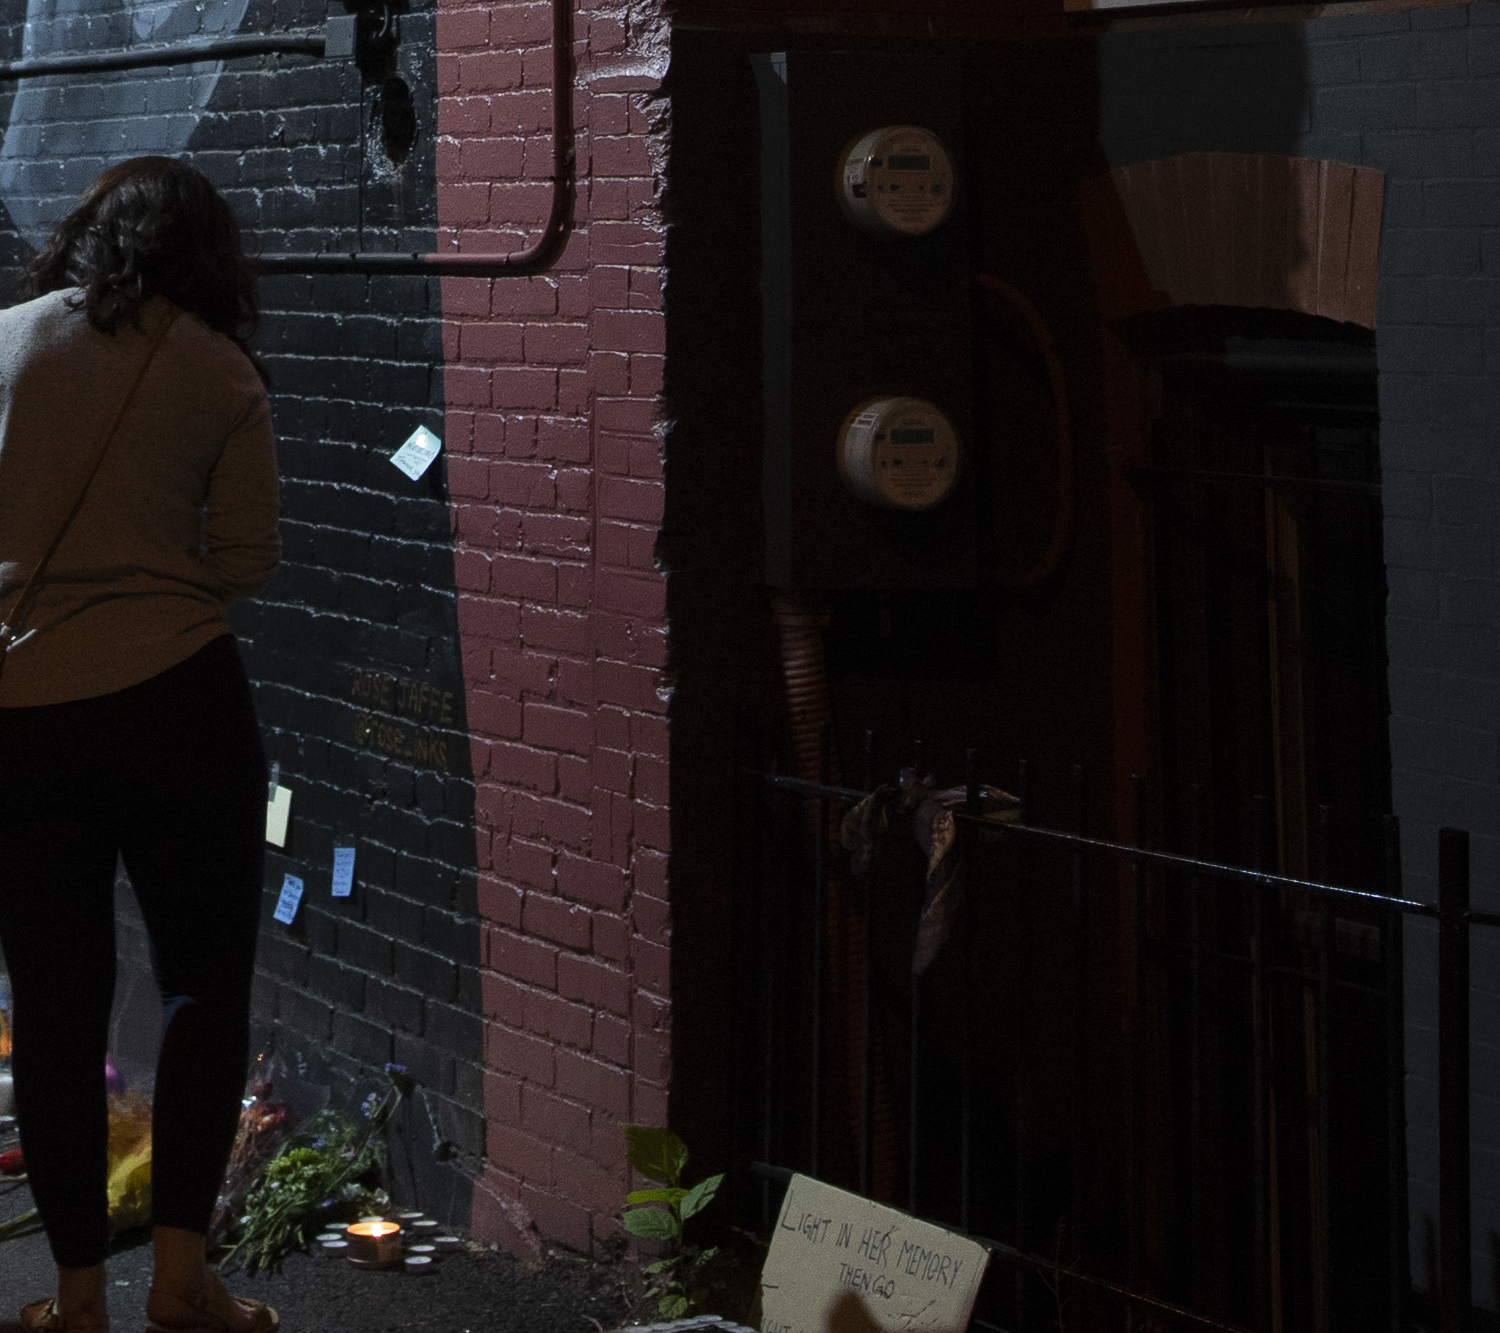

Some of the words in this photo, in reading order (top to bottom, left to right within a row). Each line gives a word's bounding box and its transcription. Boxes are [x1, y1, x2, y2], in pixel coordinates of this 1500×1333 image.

[351, 667, 390, 708] ROSE
[781, 1190, 832, 1244] LIGHT
[835, 1223, 854, 1249] IN
[858, 1227, 892, 1268] HER
[897, 1240, 964, 1290] MEMORY
[839, 1262, 871, 1292] THEN
[872, 1273, 896, 1299] GO
